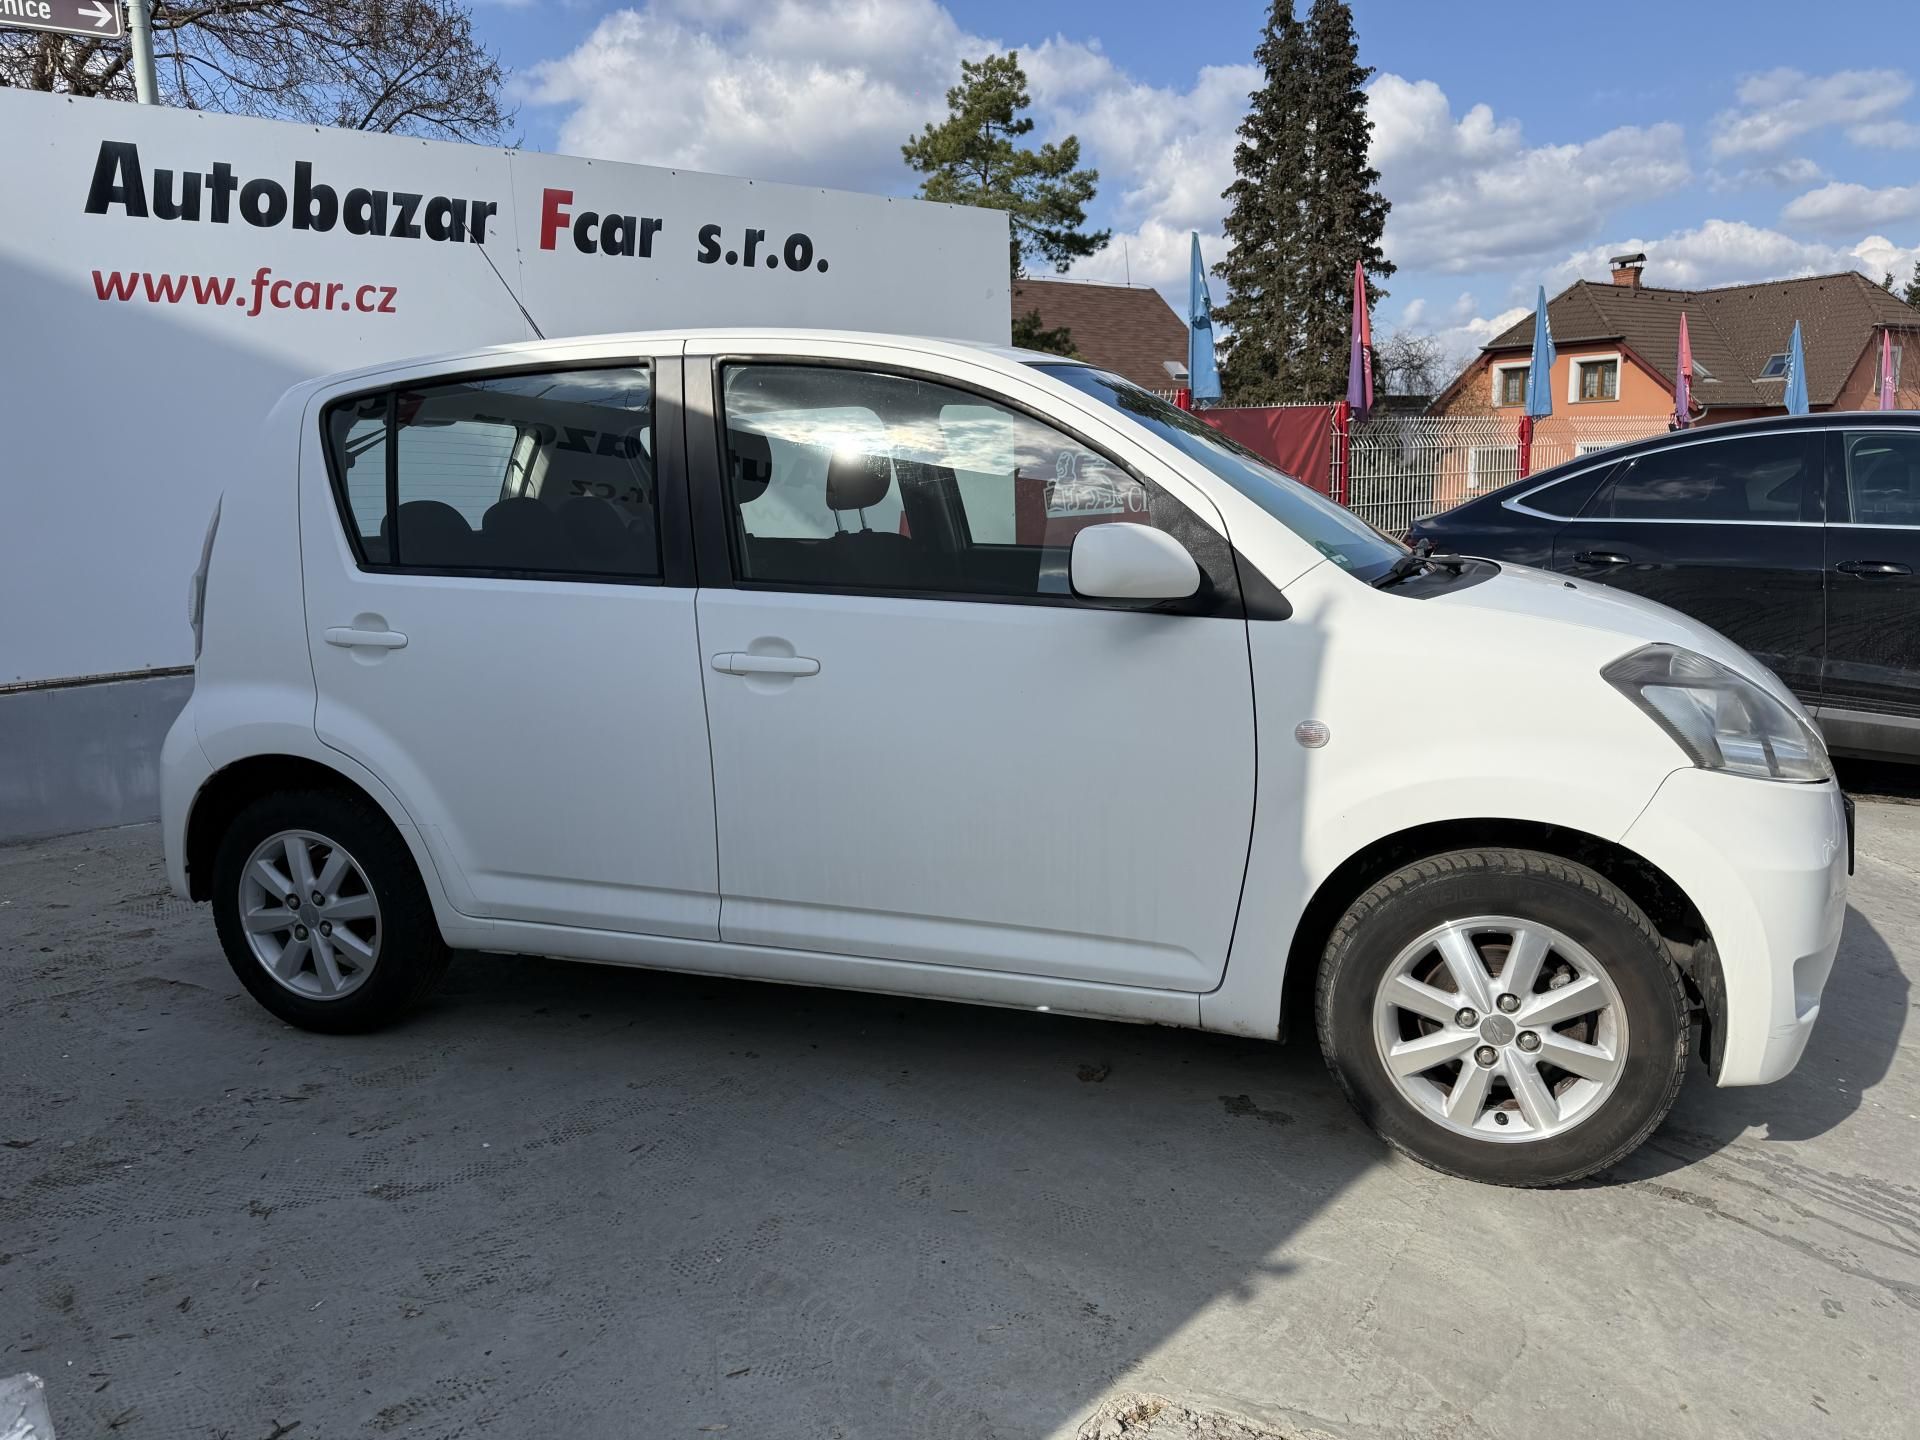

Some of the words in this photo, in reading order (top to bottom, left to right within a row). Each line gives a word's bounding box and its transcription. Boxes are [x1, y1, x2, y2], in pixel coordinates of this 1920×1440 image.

[84, 140, 497, 245] Autobazar
[540, 188, 663, 258] Fcar
[697, 223, 829, 273] s.r.o.
[91, 267, 398, 317] www.fcar.cz
